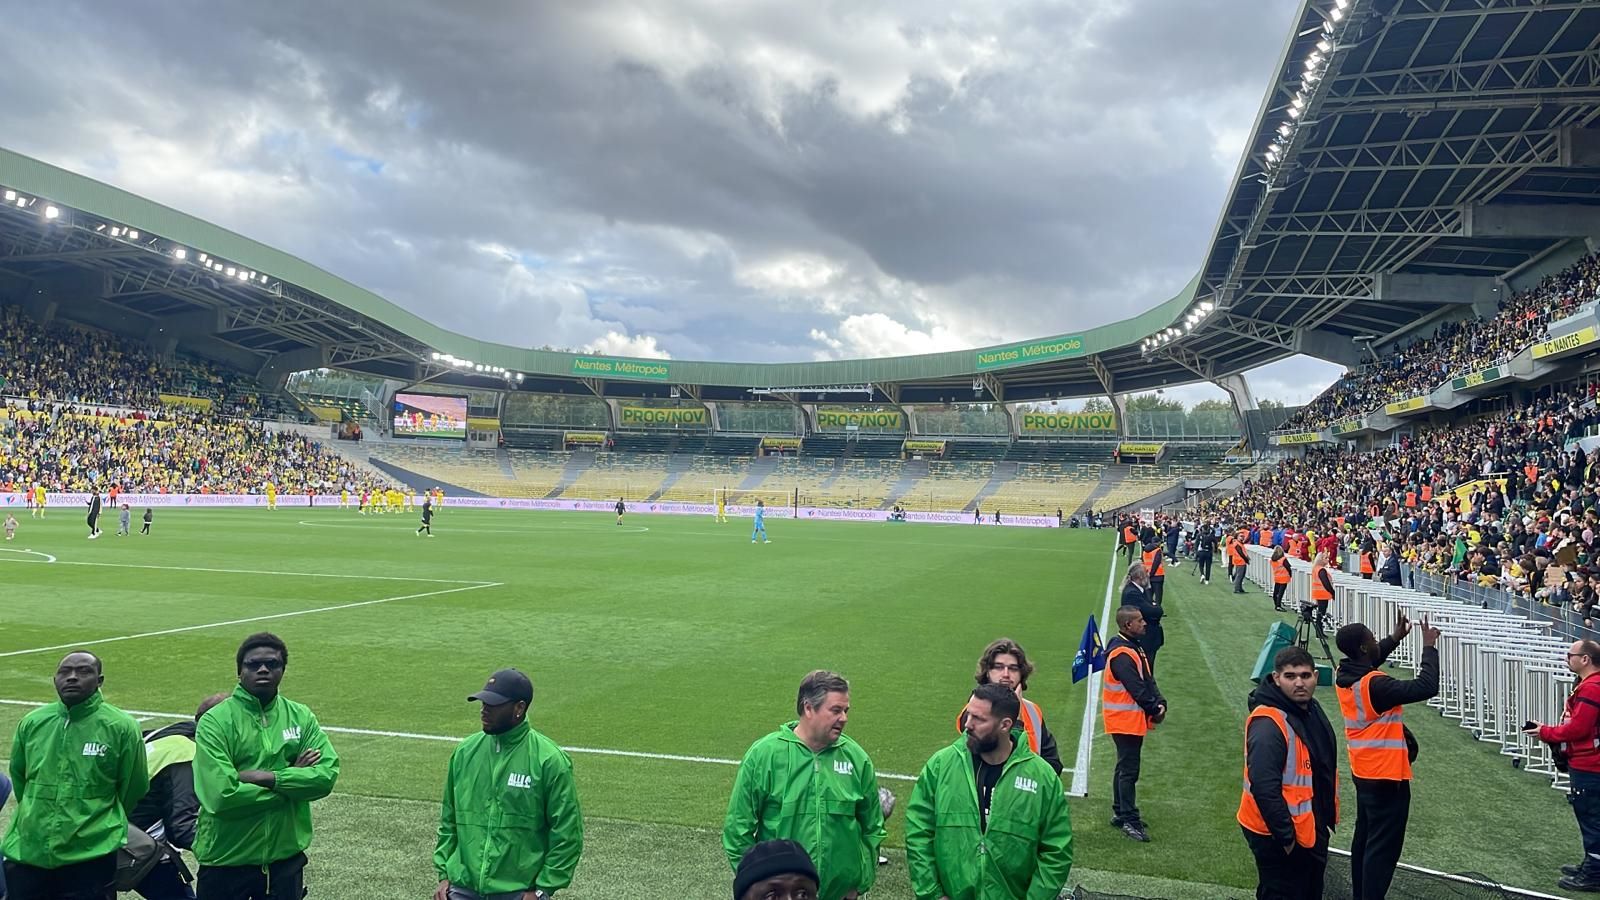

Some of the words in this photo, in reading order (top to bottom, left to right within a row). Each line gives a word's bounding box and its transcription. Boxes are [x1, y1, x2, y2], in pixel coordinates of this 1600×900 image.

[1544, 341, 1554, 354] FC
[1554, 333, 1580, 352] NANTES
[978, 350, 1019, 364] Nantes
[1022, 339, 1081, 358] Métropole
[574, 359, 611, 371] Nantes
[614, 362, 668, 376] Métropole
[623, 409, 704, 423] PROG/NOV
[1024, 415, 1113, 429] PROG/NOV
[1285, 435, 1292, 443] FC
[1292, 434, 1313, 442] NANTES
[817, 509, 842, 517] Nantes
[842, 510, 876, 520] Métropole
